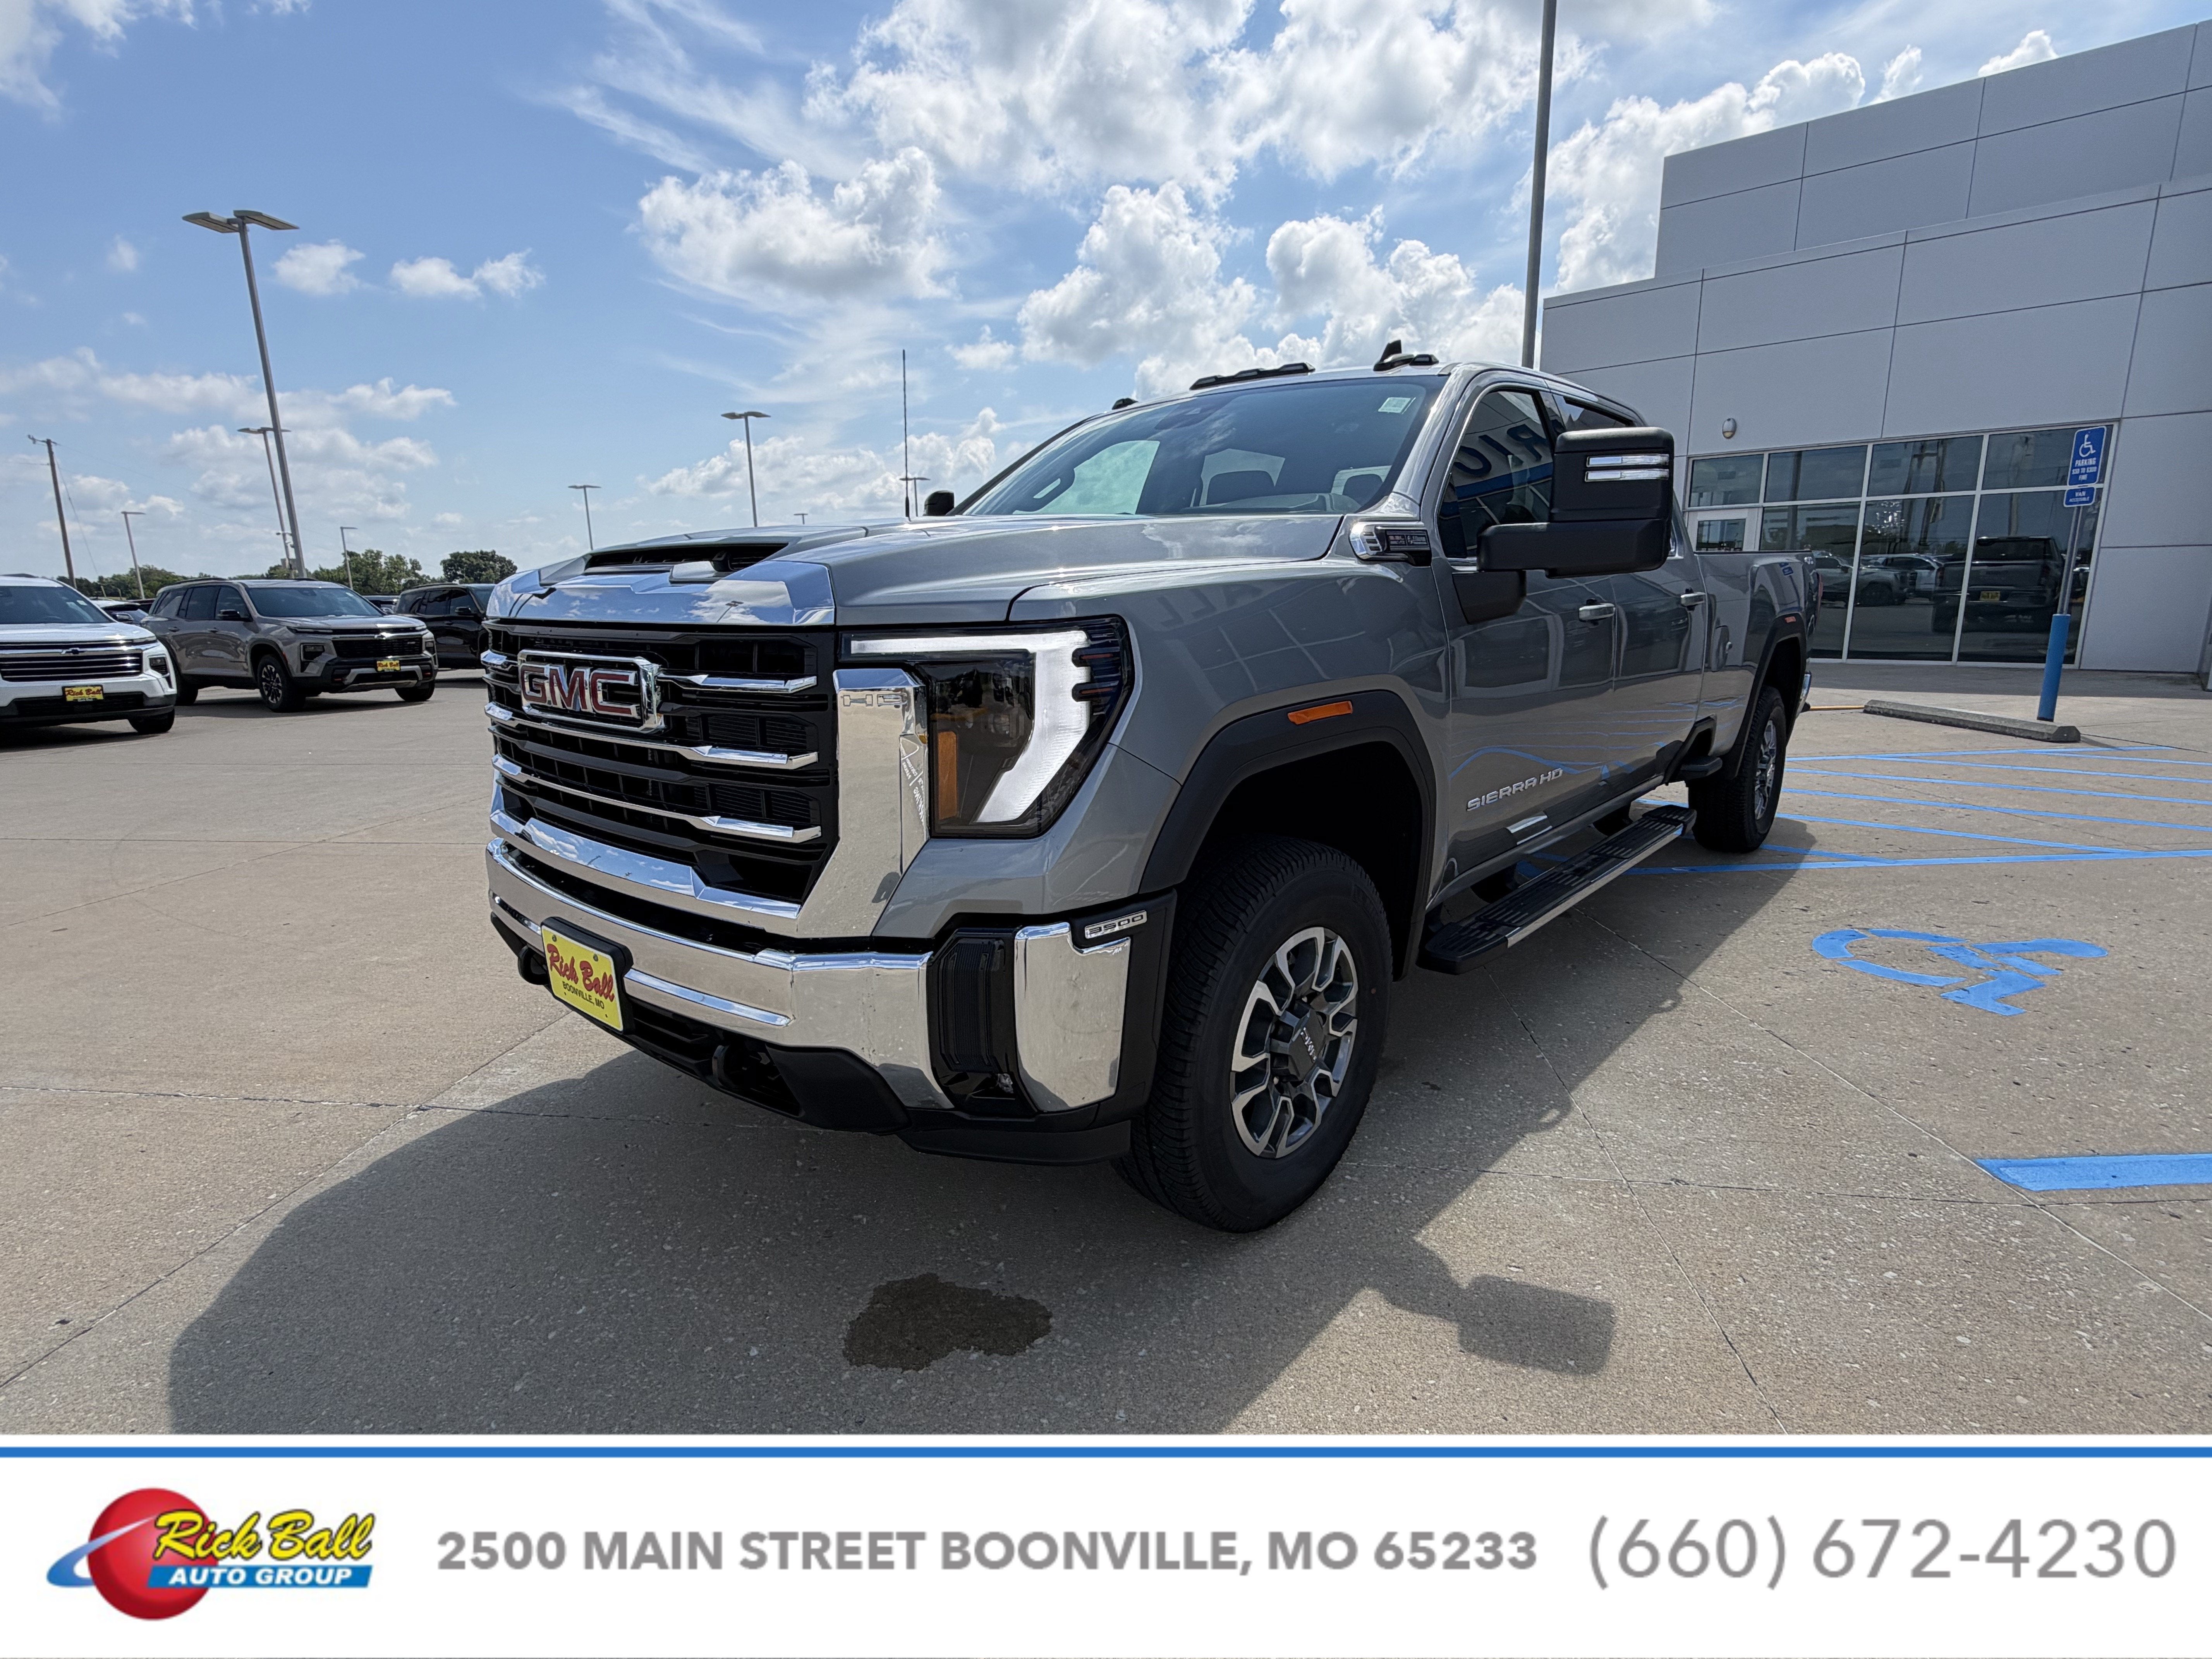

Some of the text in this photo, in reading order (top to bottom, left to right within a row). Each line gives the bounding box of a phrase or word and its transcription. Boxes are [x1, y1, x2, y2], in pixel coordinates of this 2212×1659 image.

[2075, 457, 2097, 467] PARKING
[519, 663, 640, 719] GMC
[1467, 768, 1563, 811] SIERRA HD
[1089, 914, 1144, 935] 3500
[546, 943, 615, 1002] Rick Ball
[562, 981, 605, 1009] BOONVILLE, MO
